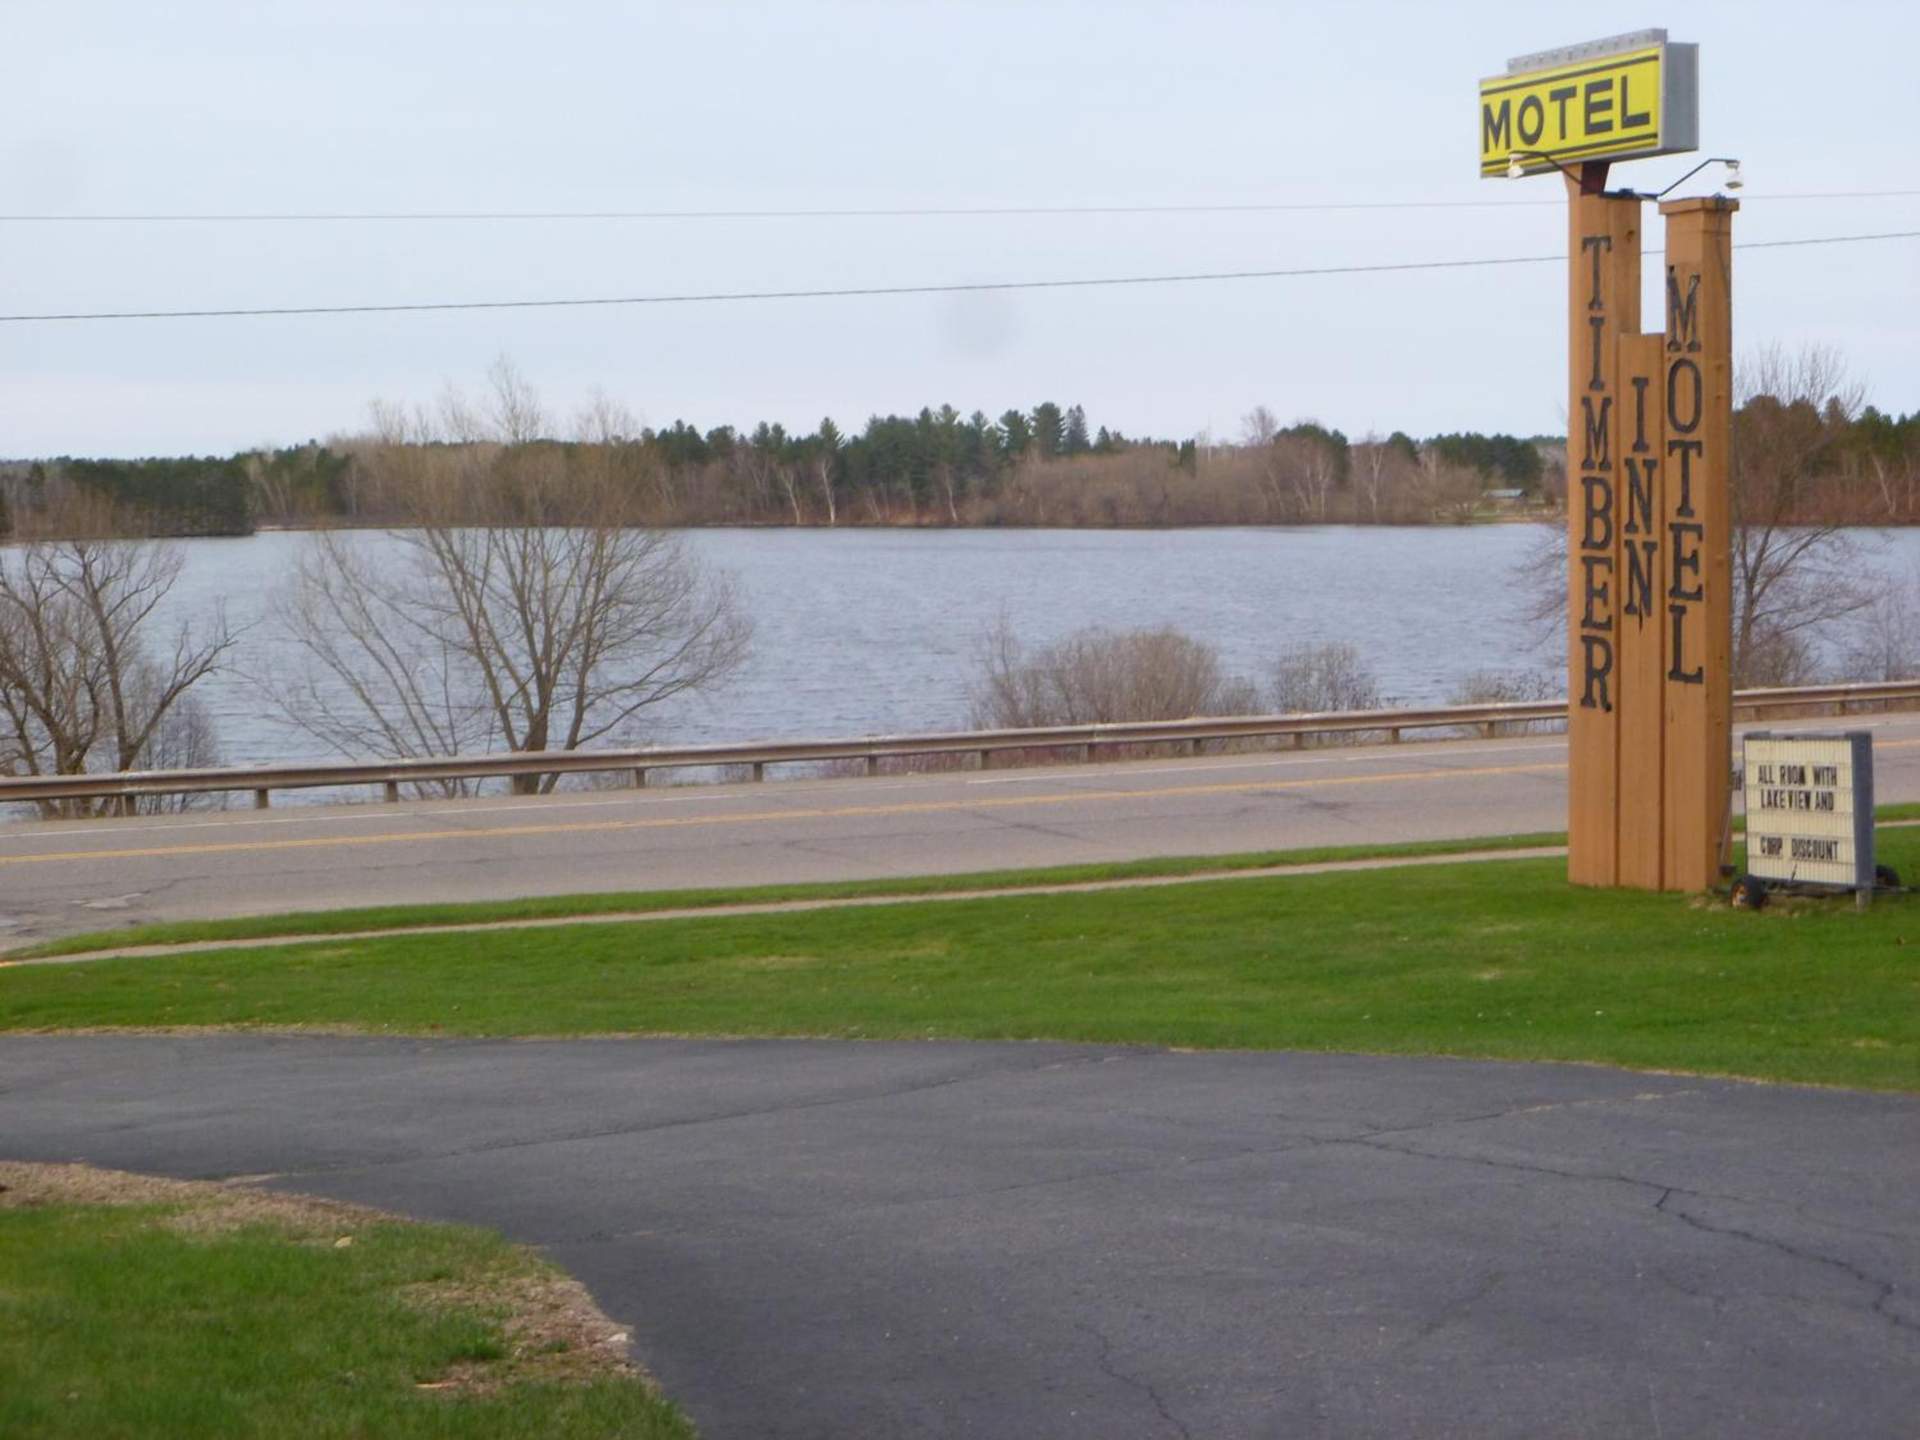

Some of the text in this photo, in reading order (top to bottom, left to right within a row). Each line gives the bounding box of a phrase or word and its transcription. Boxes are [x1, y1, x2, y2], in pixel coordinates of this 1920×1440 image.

[1483, 75, 1649, 153] MOTEL
[1581, 236, 1613, 712] TIMBER
[1624, 377, 1657, 618] INN
[1667, 272, 1703, 684] MOTEL
[1758, 765, 1775, 785] ALL
[1813, 766, 1838, 786] WITH
[1761, 789, 1834, 811] LAKE VIEW AND
[1791, 839, 1839, 860] DISCOUNT
